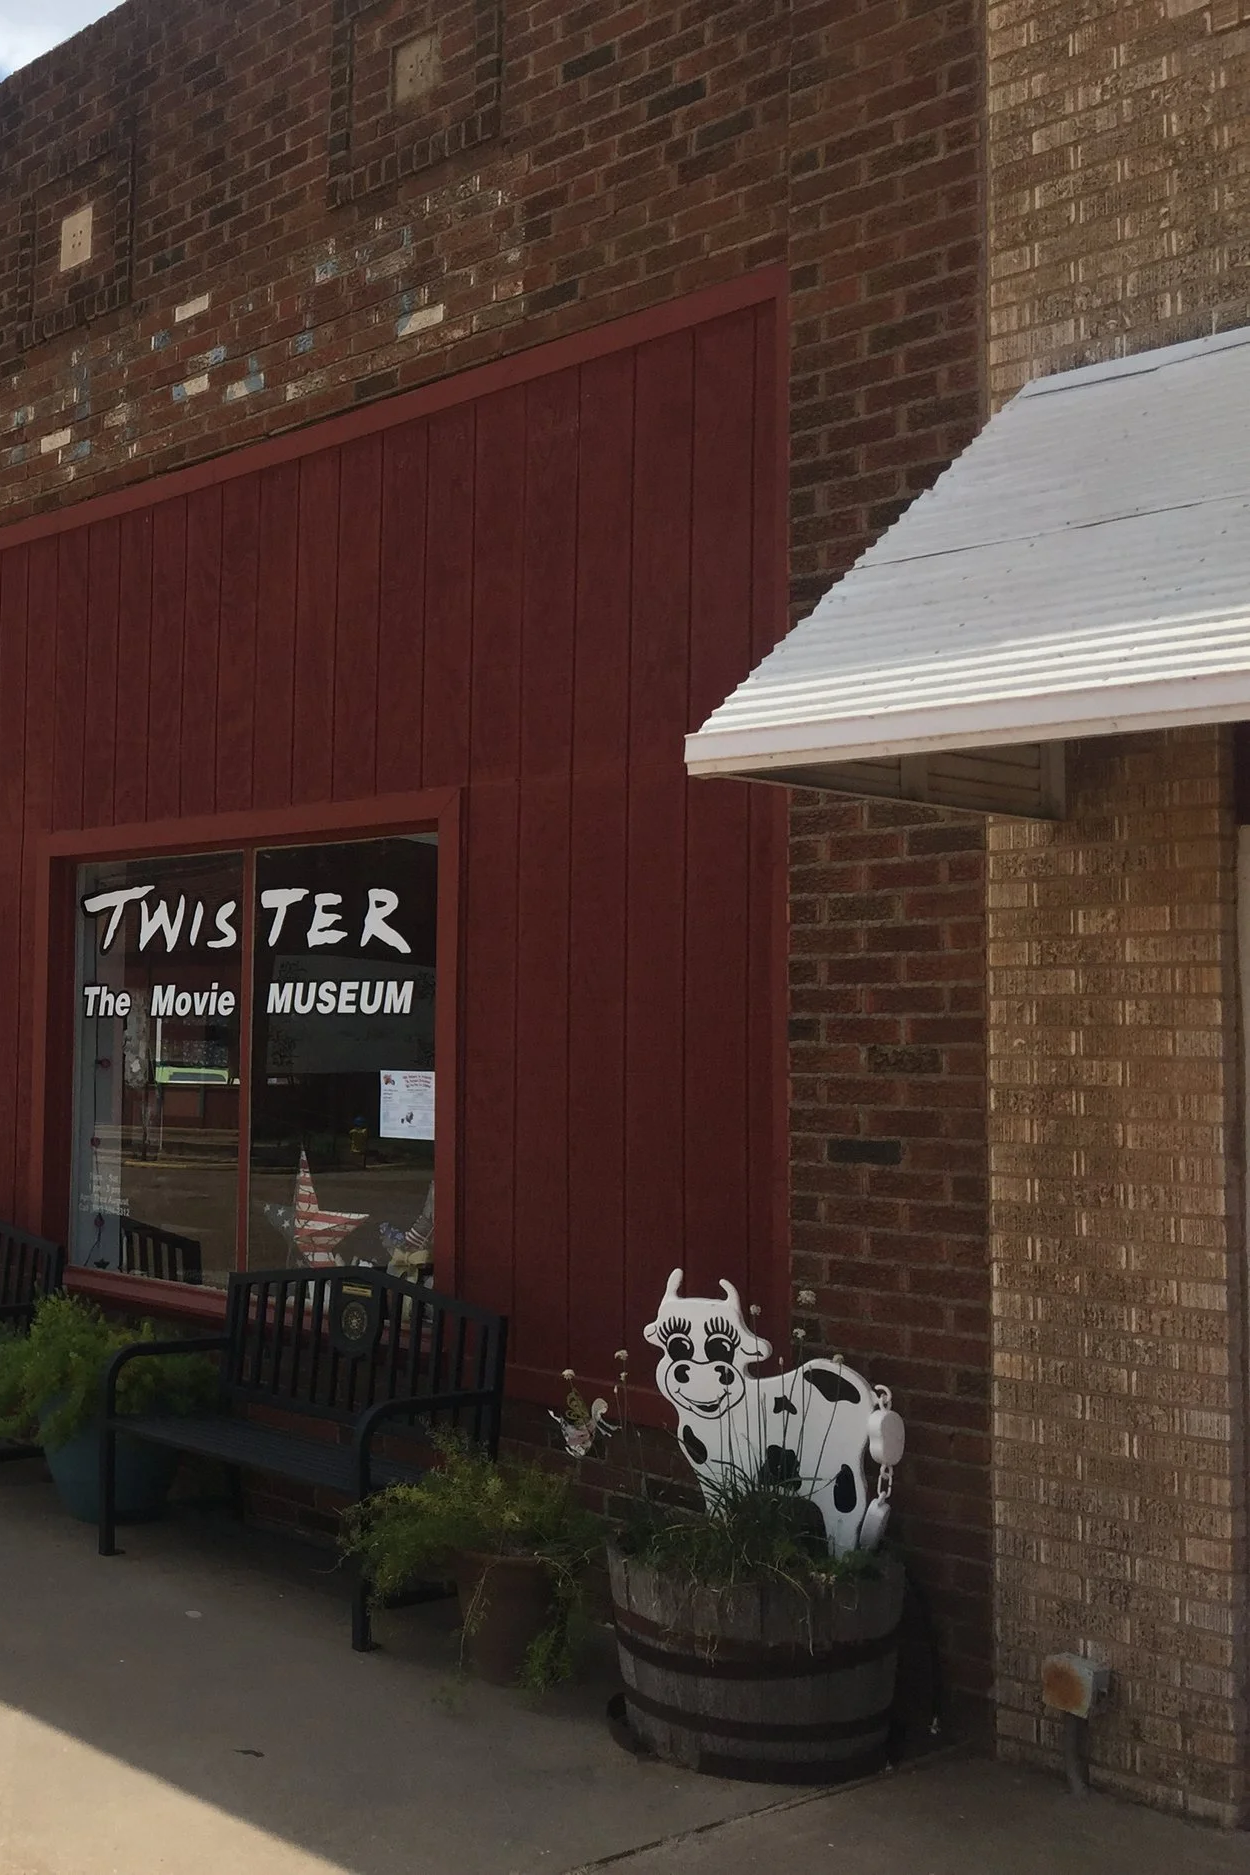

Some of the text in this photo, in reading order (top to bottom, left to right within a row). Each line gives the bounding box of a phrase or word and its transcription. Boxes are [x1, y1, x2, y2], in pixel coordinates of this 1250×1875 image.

[83, 980, 414, 1018] The Movie MUSEUM
